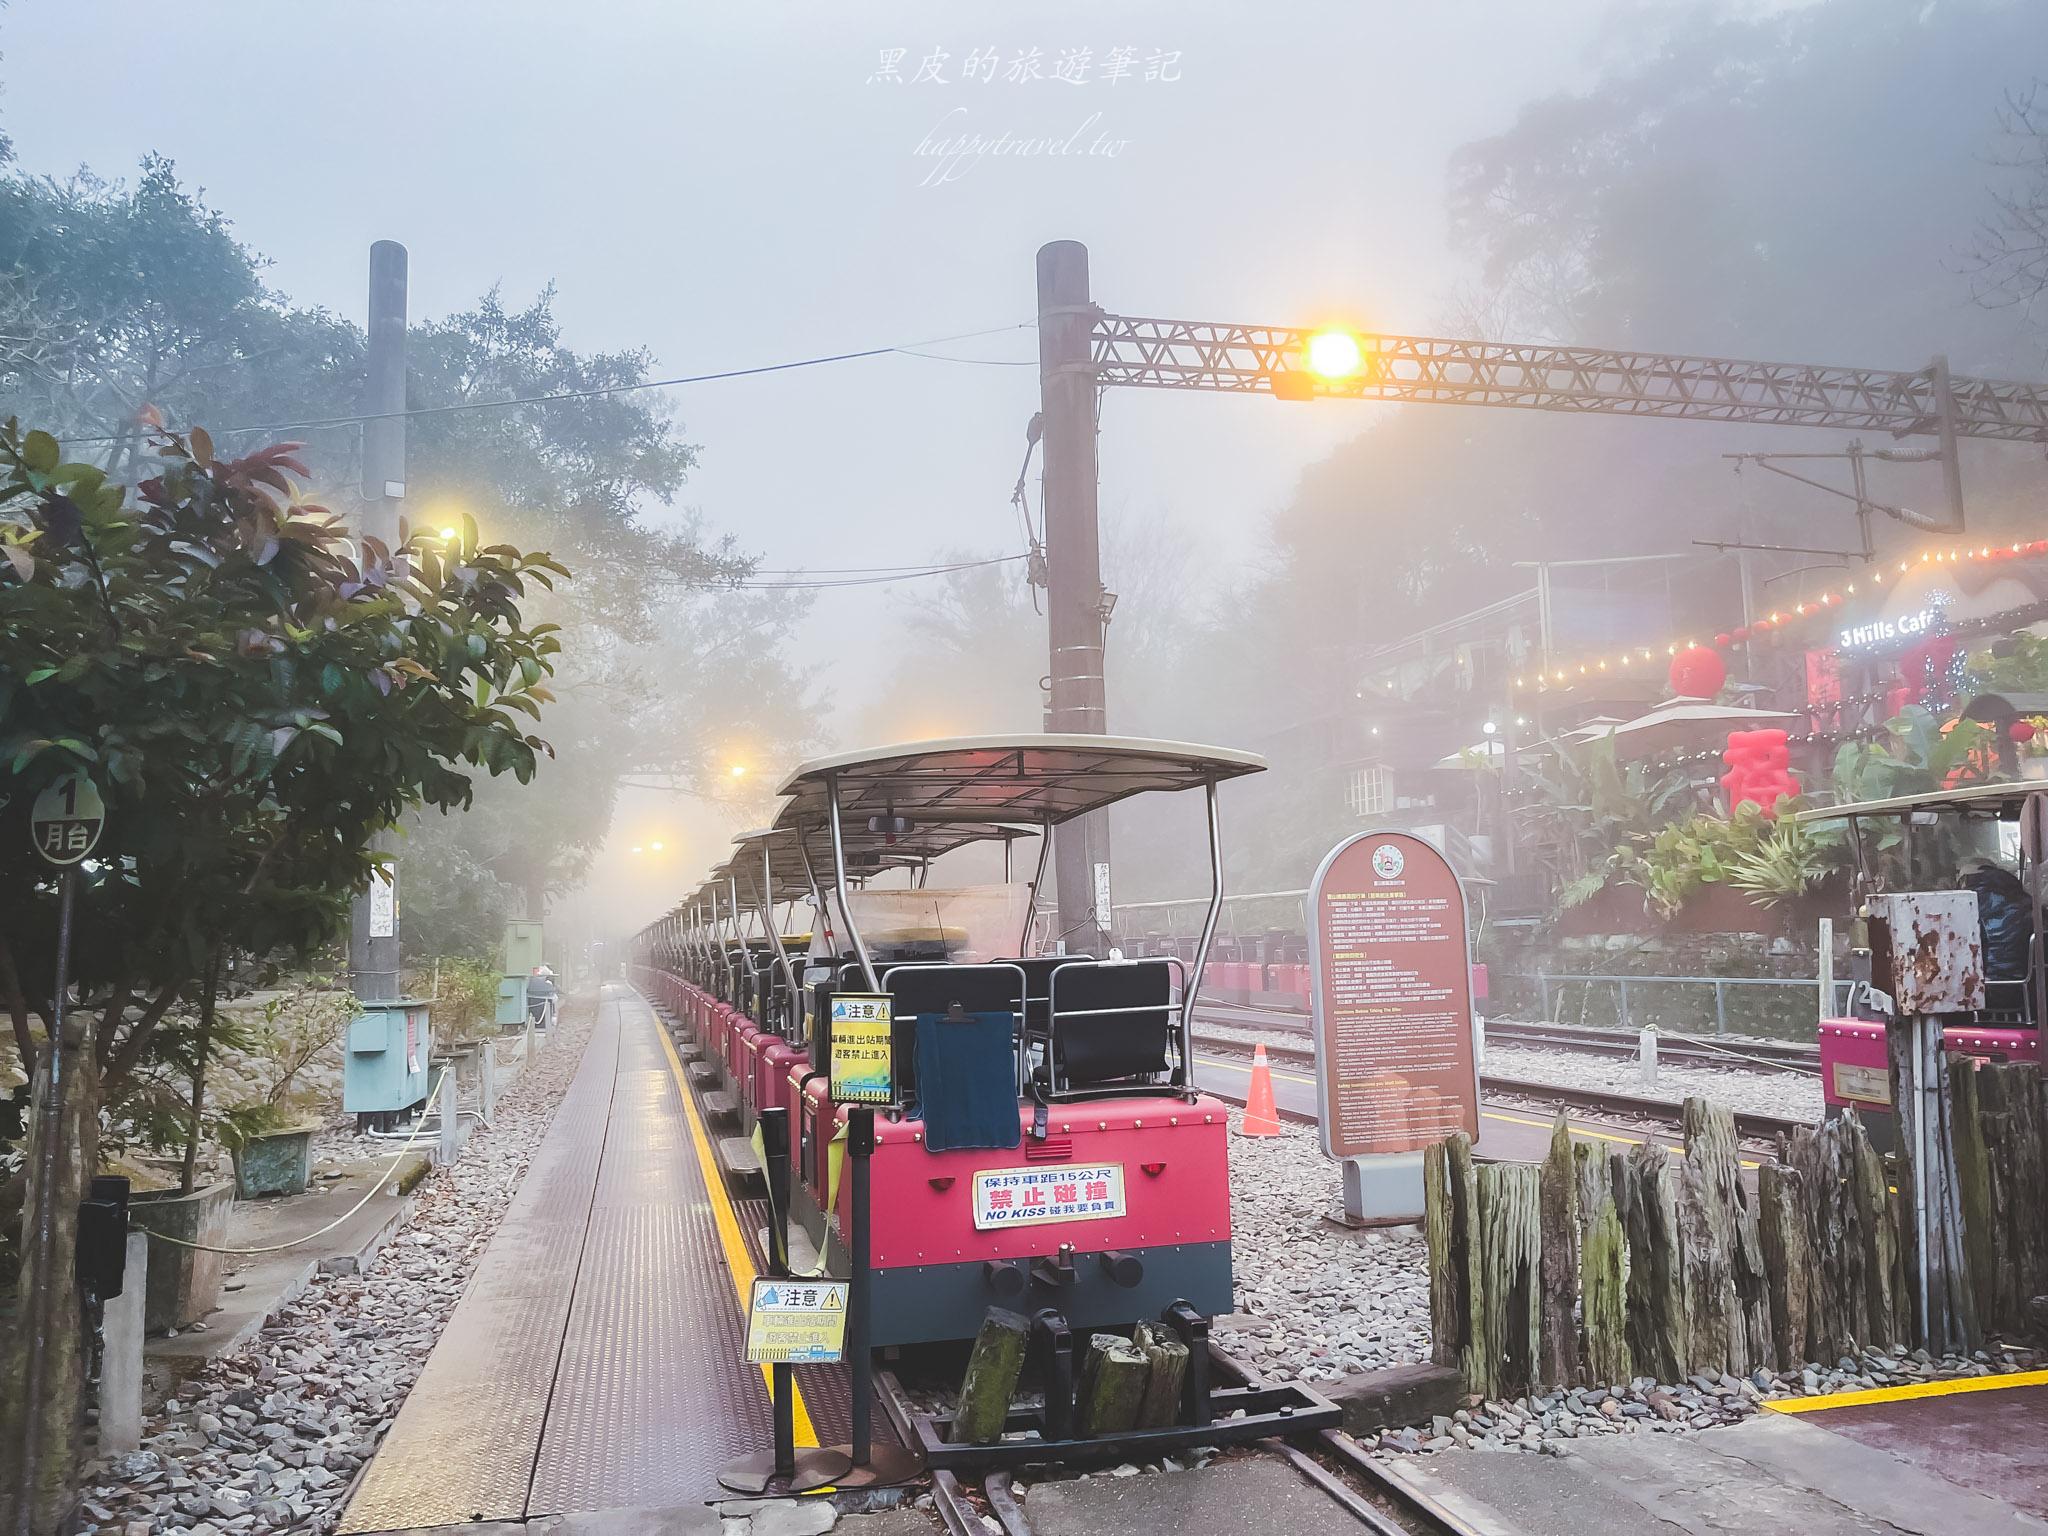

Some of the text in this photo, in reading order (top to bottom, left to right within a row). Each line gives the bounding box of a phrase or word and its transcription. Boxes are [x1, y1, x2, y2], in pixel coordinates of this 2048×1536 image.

[58, 778, 77, 816] 1
[44, 822, 89, 851] 月台
[848, 1004, 875, 1019] 注意
[984, 1169, 1112, 1188] 保持車距15公尺
[989, 1181, 1108, 1210] 禁止碰撞
[985, 1211, 1007, 1221] NO
[1011, 1207, 1046, 1218] KISS
[784, 1289, 818, 1307] 注意
